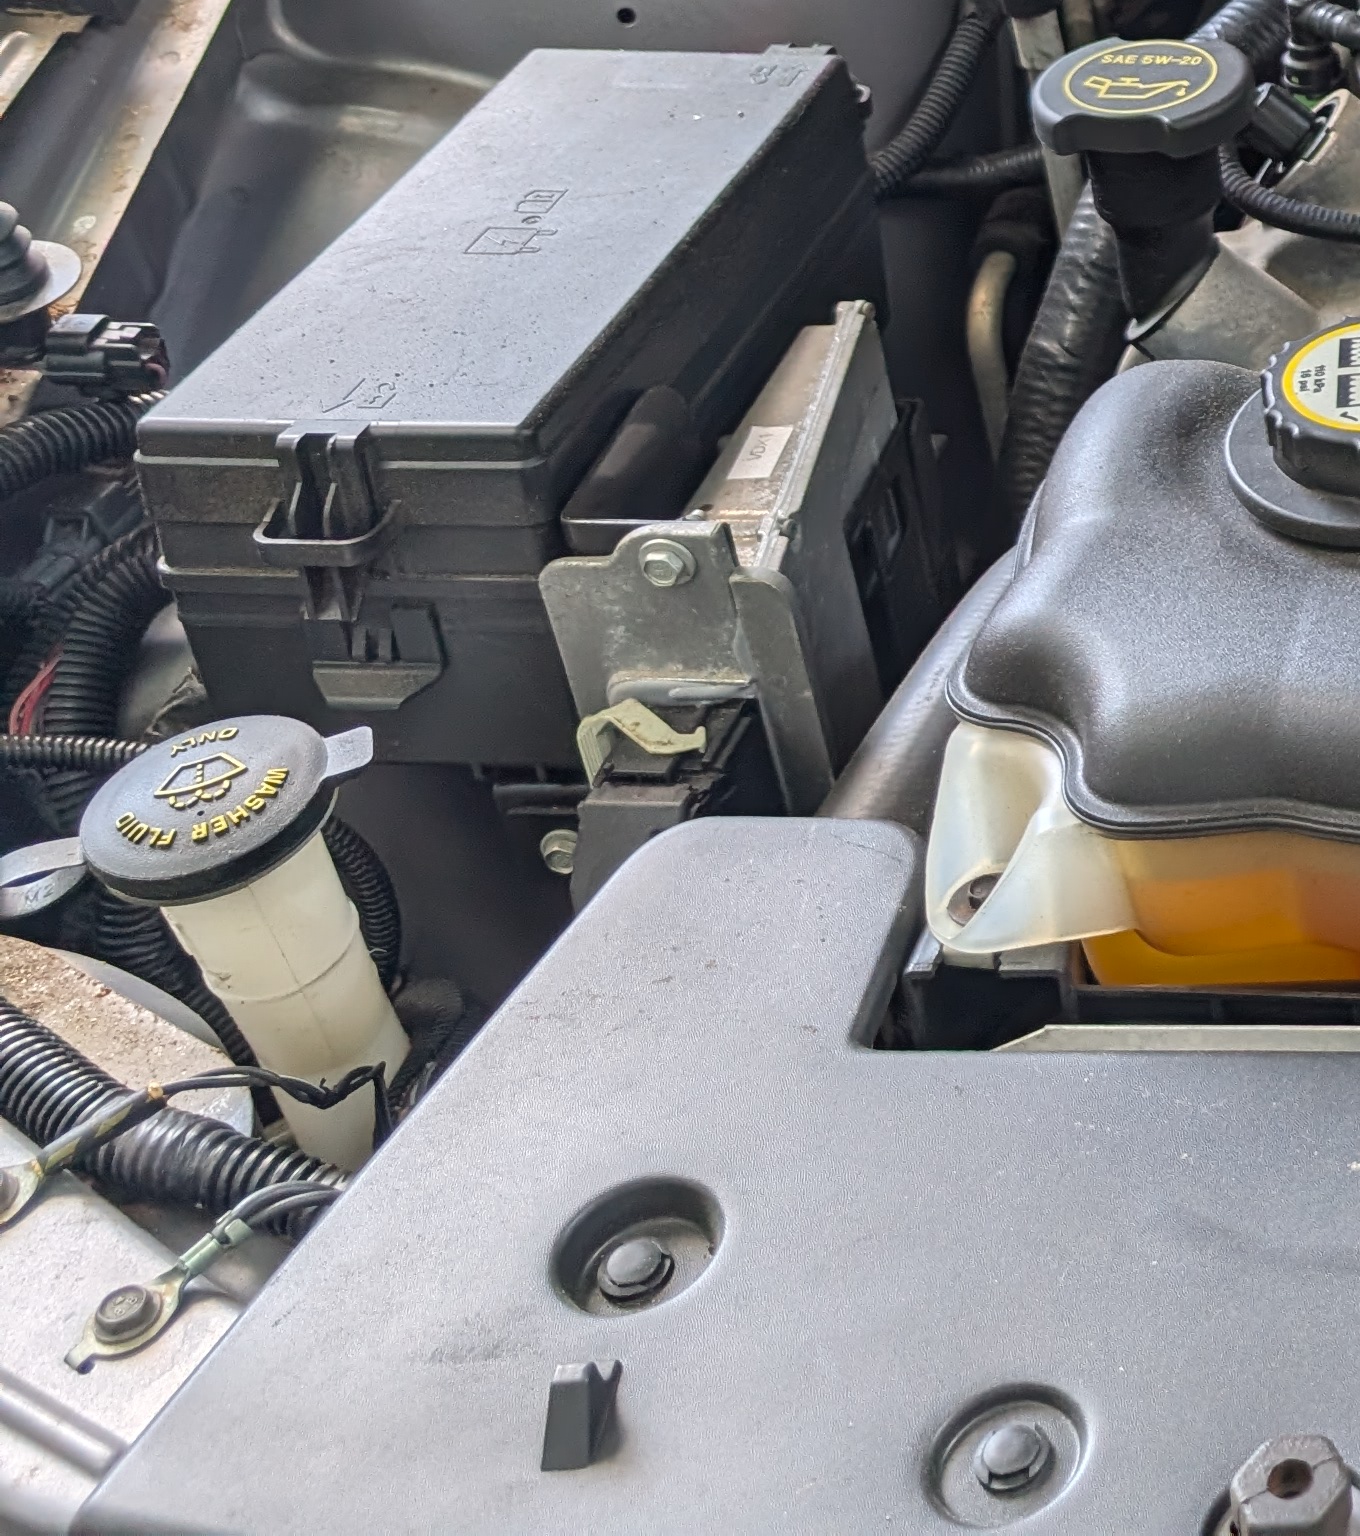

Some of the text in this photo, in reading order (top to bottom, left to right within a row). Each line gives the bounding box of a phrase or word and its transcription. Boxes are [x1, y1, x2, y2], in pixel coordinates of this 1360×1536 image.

[1100, 54, 1203, 66] SAE 5W-20
[171, 726, 239, 758] ONLY
[115, 766, 290, 848] WASHER FLUID
